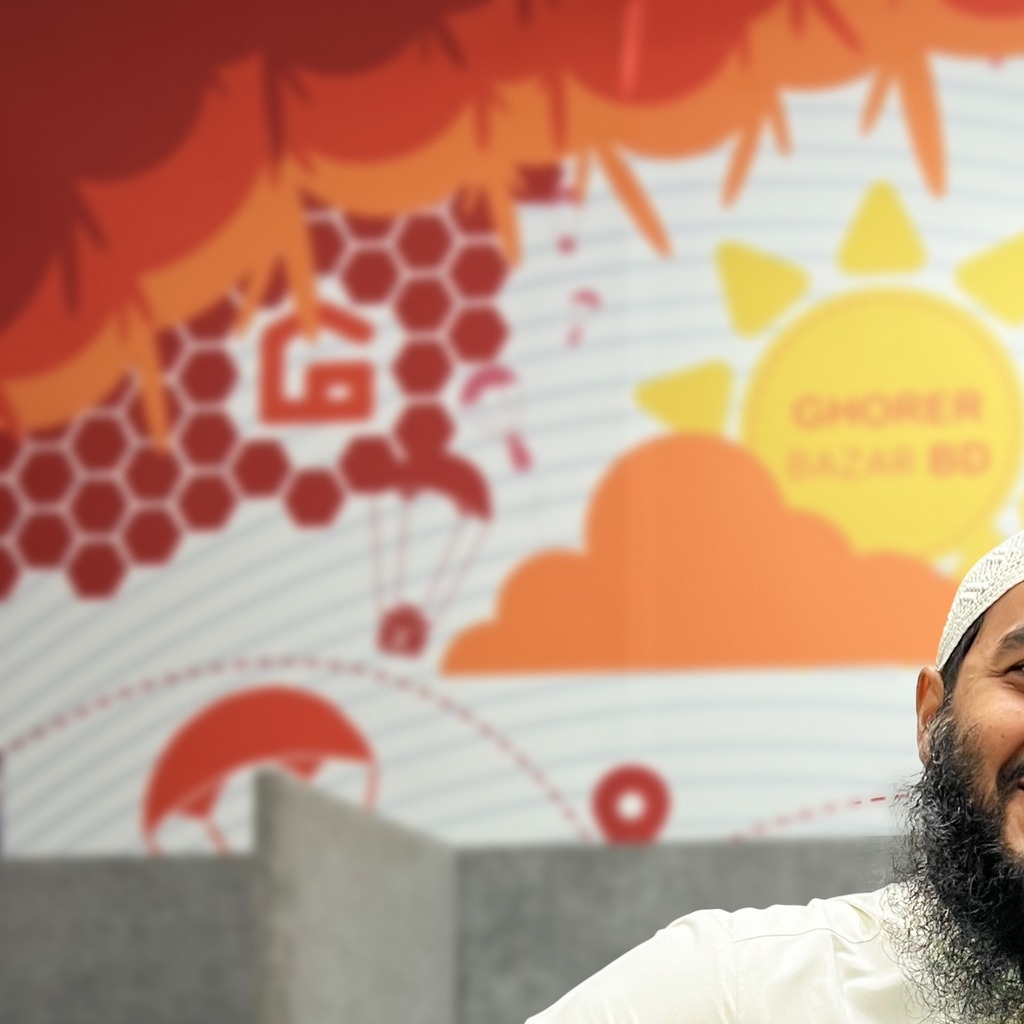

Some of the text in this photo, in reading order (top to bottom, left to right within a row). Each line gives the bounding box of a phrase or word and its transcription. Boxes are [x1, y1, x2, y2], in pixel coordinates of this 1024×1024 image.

[792, 389, 983, 432] GHORER
[786, 440, 993, 484] BAZAR BD
